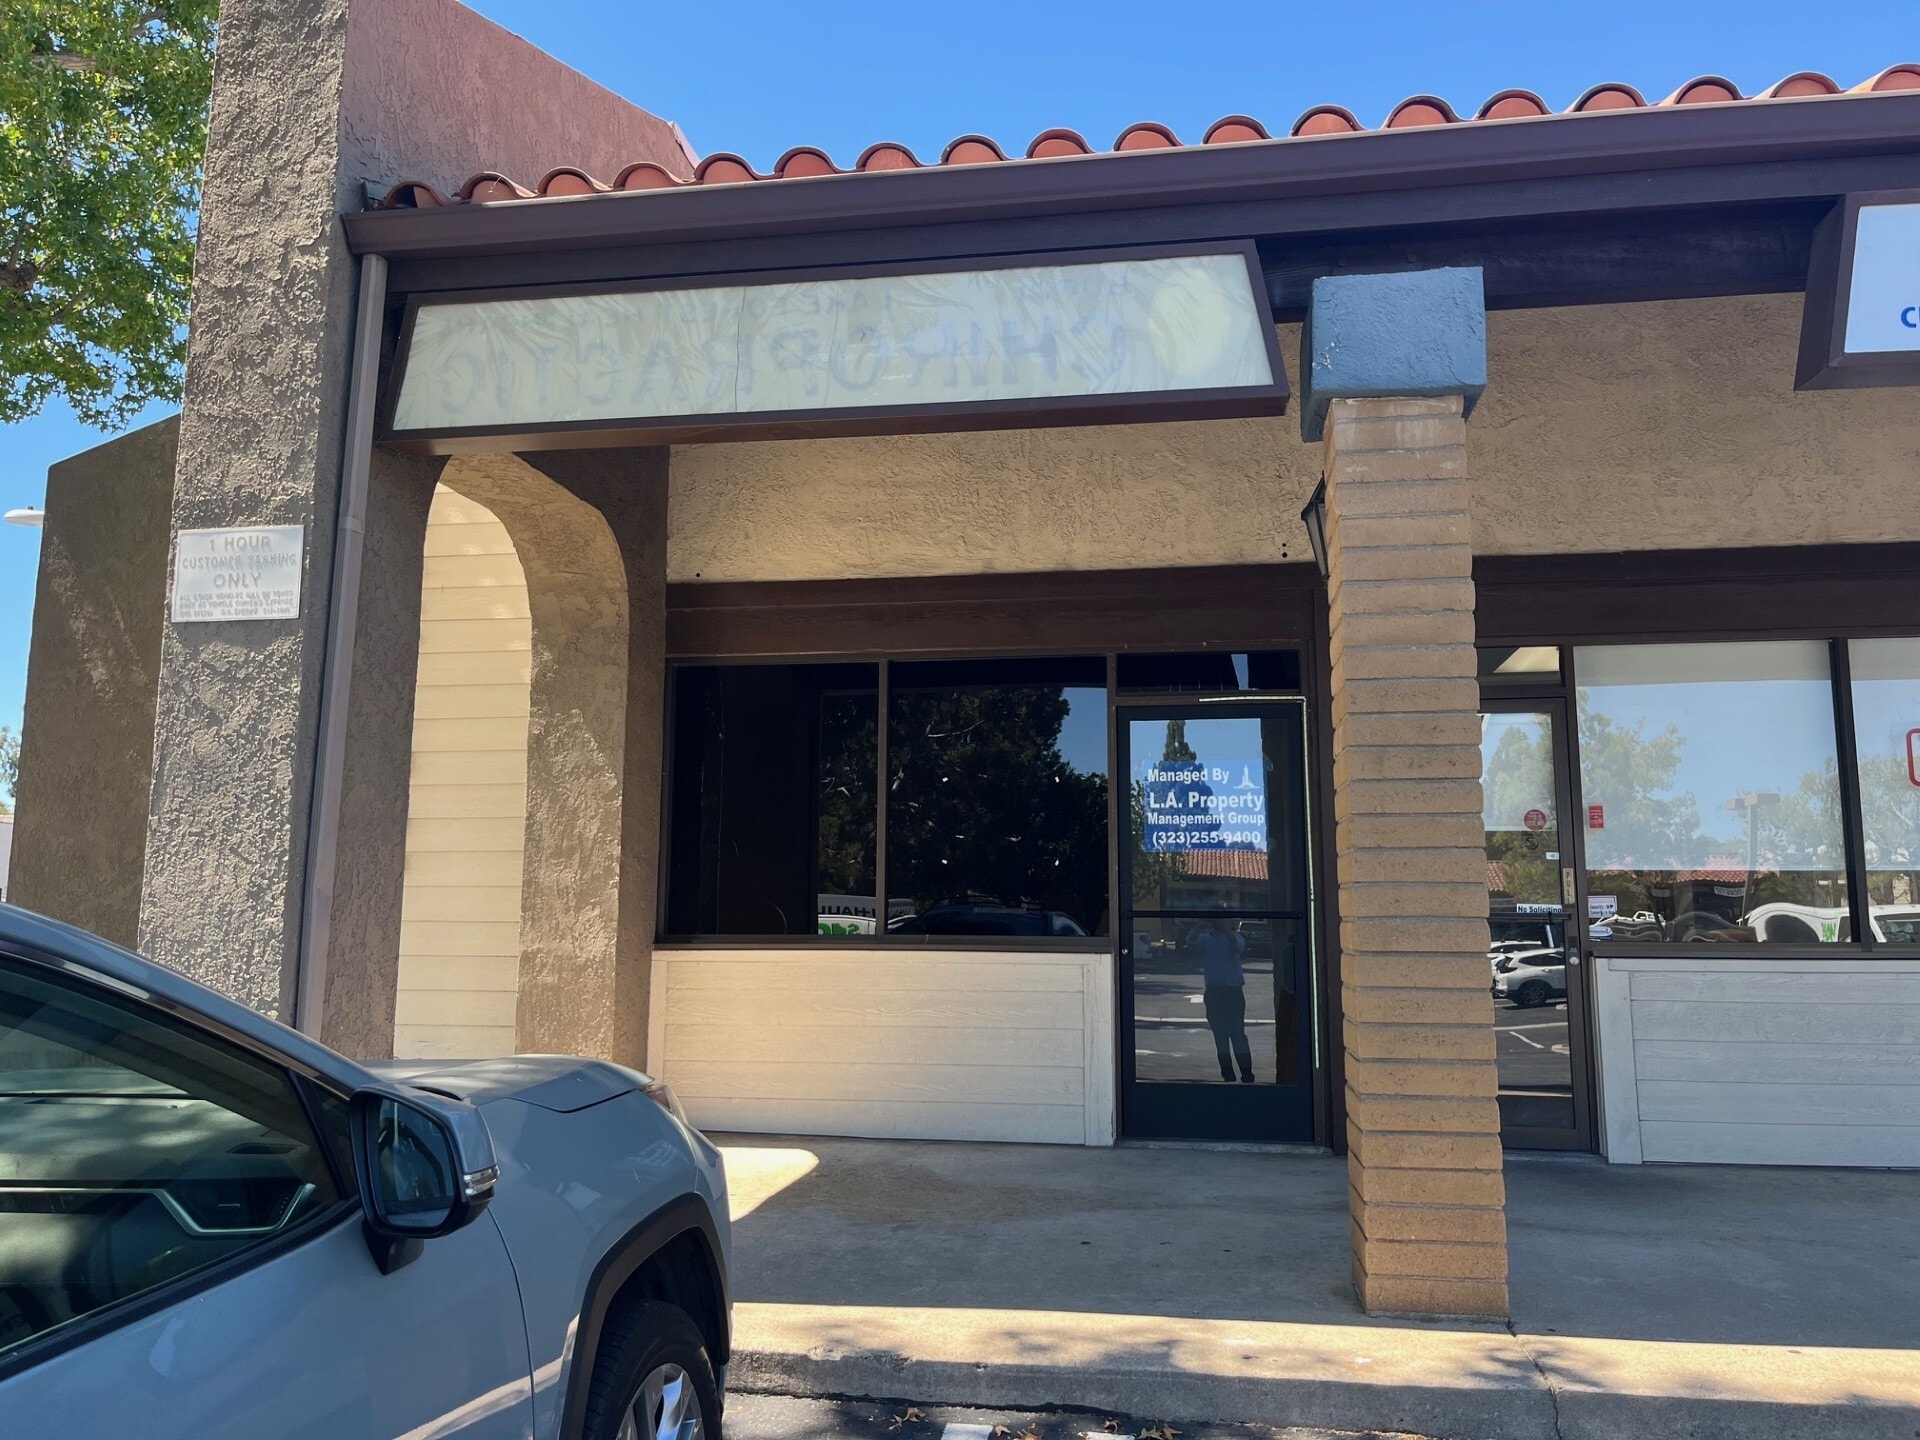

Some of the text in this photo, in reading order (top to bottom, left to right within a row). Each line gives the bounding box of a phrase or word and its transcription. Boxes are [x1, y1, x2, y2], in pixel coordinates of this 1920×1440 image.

[1900, 306, 1920, 328] C
[209, 535, 272, 553] 1 HOUR
[182, 553, 297, 570] CUSTOMER PARKING
[213, 572, 262, 589] ONLY
[1148, 768, 1230, 784] Managed By
[1150, 791, 1263, 812] L.A. Property
[1148, 812, 1264, 827] Management Group
[1152, 831, 1261, 846] (323)255-9400
[1518, 904, 1562, 913] No Soliciting
